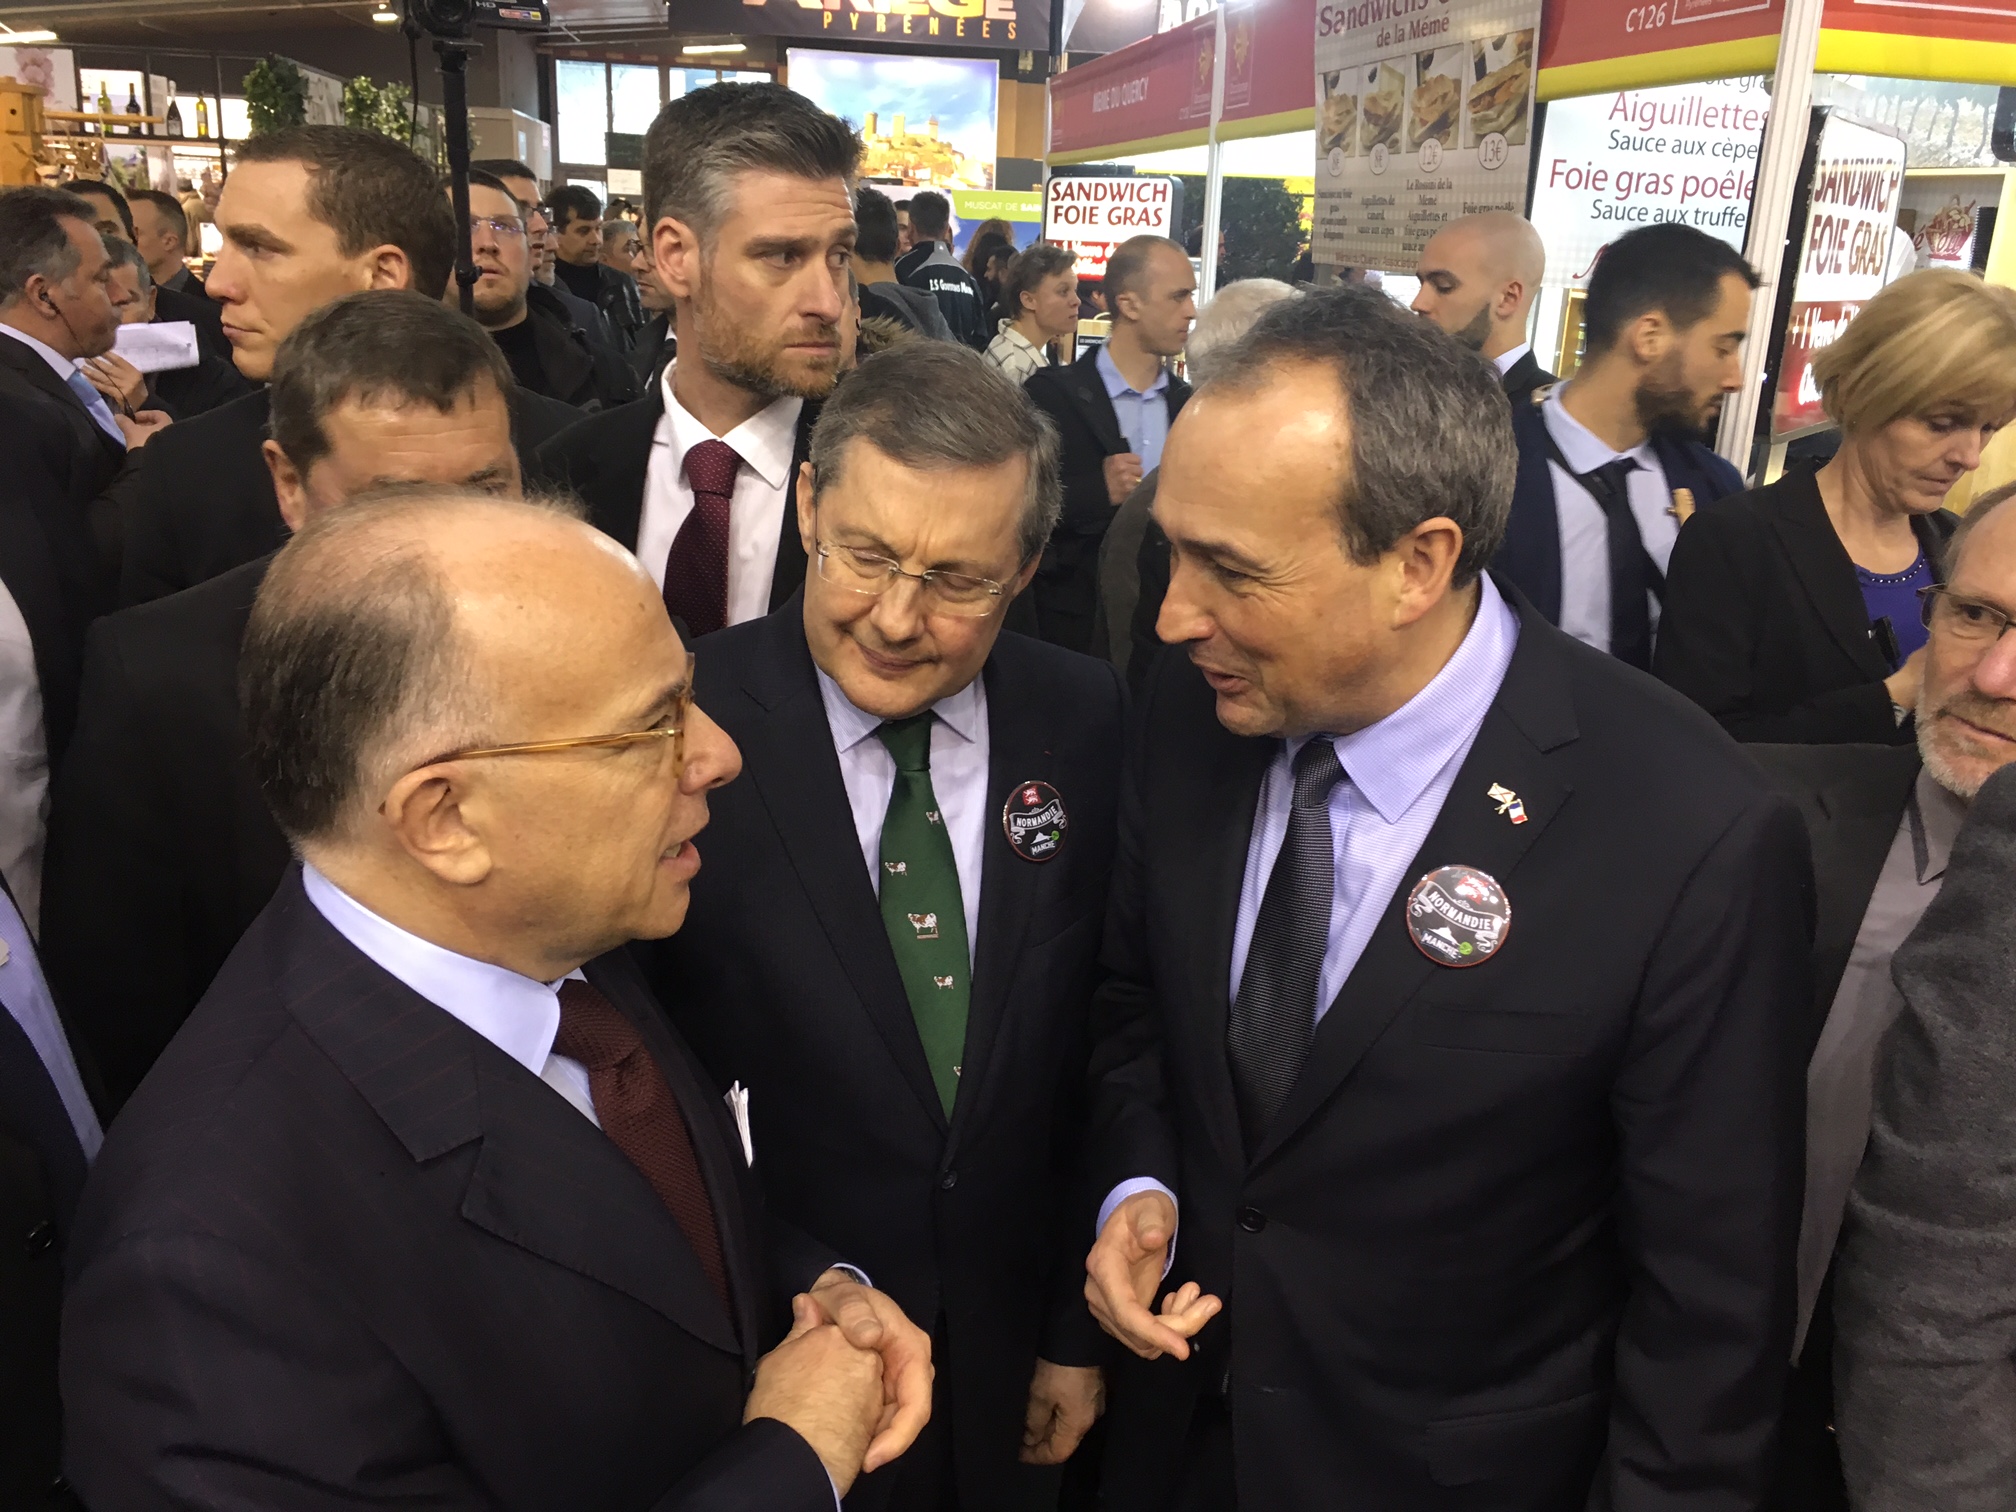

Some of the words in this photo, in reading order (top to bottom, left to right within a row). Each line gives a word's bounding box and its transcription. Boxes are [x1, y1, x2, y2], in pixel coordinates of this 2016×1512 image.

[1376, 27, 1391, 48] de
[1394, 23, 1405, 44] la
[1409, 10, 1450, 40] Mémé
[1625, 2, 1668, 33] C126
[1483, 138, 1503, 162] 13€
[1608, 129, 1666, 153] Sauce
[1671, 138, 1706, 156] aux
[1050, 181, 1168, 203] SANDWICH
[1549, 158, 1608, 191] Foie
[1615, 170, 1675, 201] gras
[1814, 158, 1900, 213] SANDWICH
[964, 200, 1003, 210] MUSCAT
[1005, 202, 1018, 211] DE
[1053, 205, 1099, 225] FOIE
[1107, 206, 1163, 227] GRAS
[1591, 198, 1649, 222] Sauce
[1653, 207, 1689, 223] aux
[1804, 214, 1850, 276] FOIE
[1848, 219, 1888, 276] GRAS
[1016, 805, 1058, 827] NORMANDIE
[1031, 840, 1056, 856] MANCHE
[1427, 890, 1492, 930] NORMANDIE
[1420, 933, 1461, 959] MANCHE
